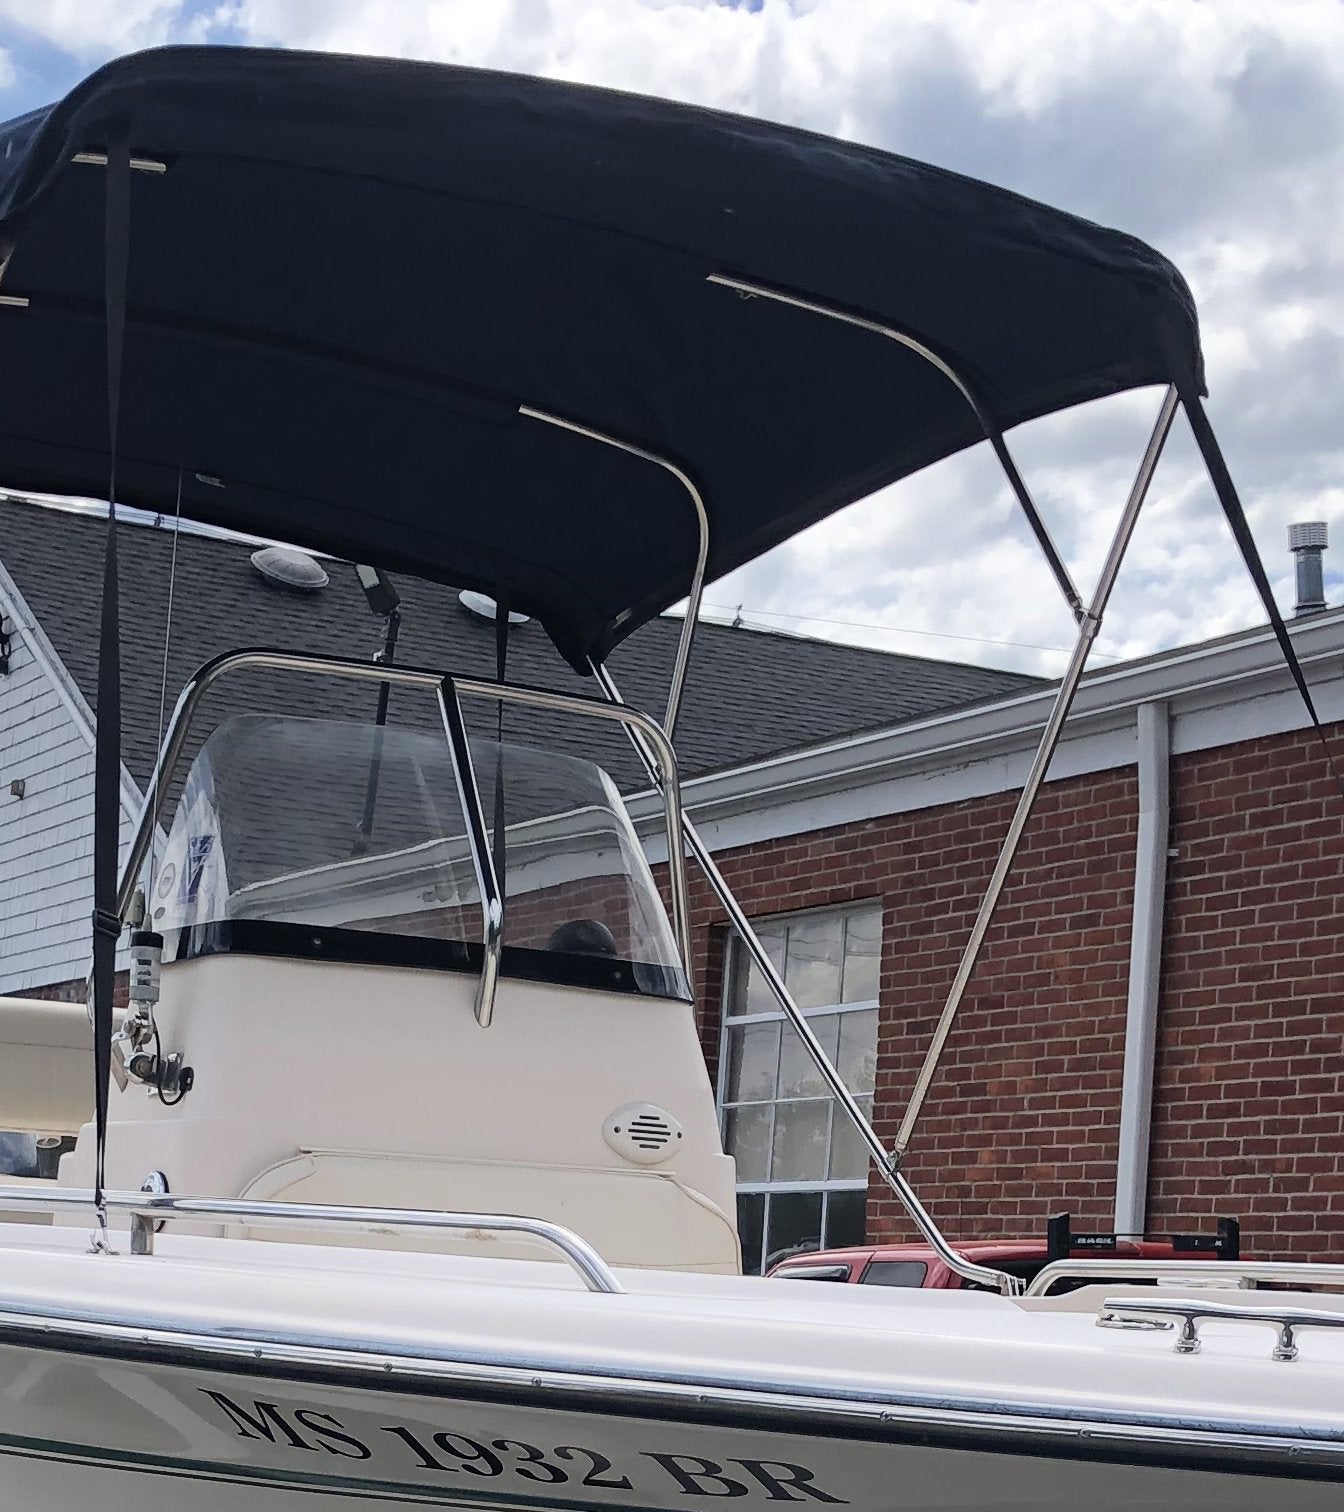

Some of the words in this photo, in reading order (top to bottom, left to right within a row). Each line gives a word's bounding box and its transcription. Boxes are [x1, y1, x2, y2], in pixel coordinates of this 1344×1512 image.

[197, 1388, 372, 1460] MS
[380, 1425, 634, 1490] 1932
[638, 1451, 851, 1504] BR
